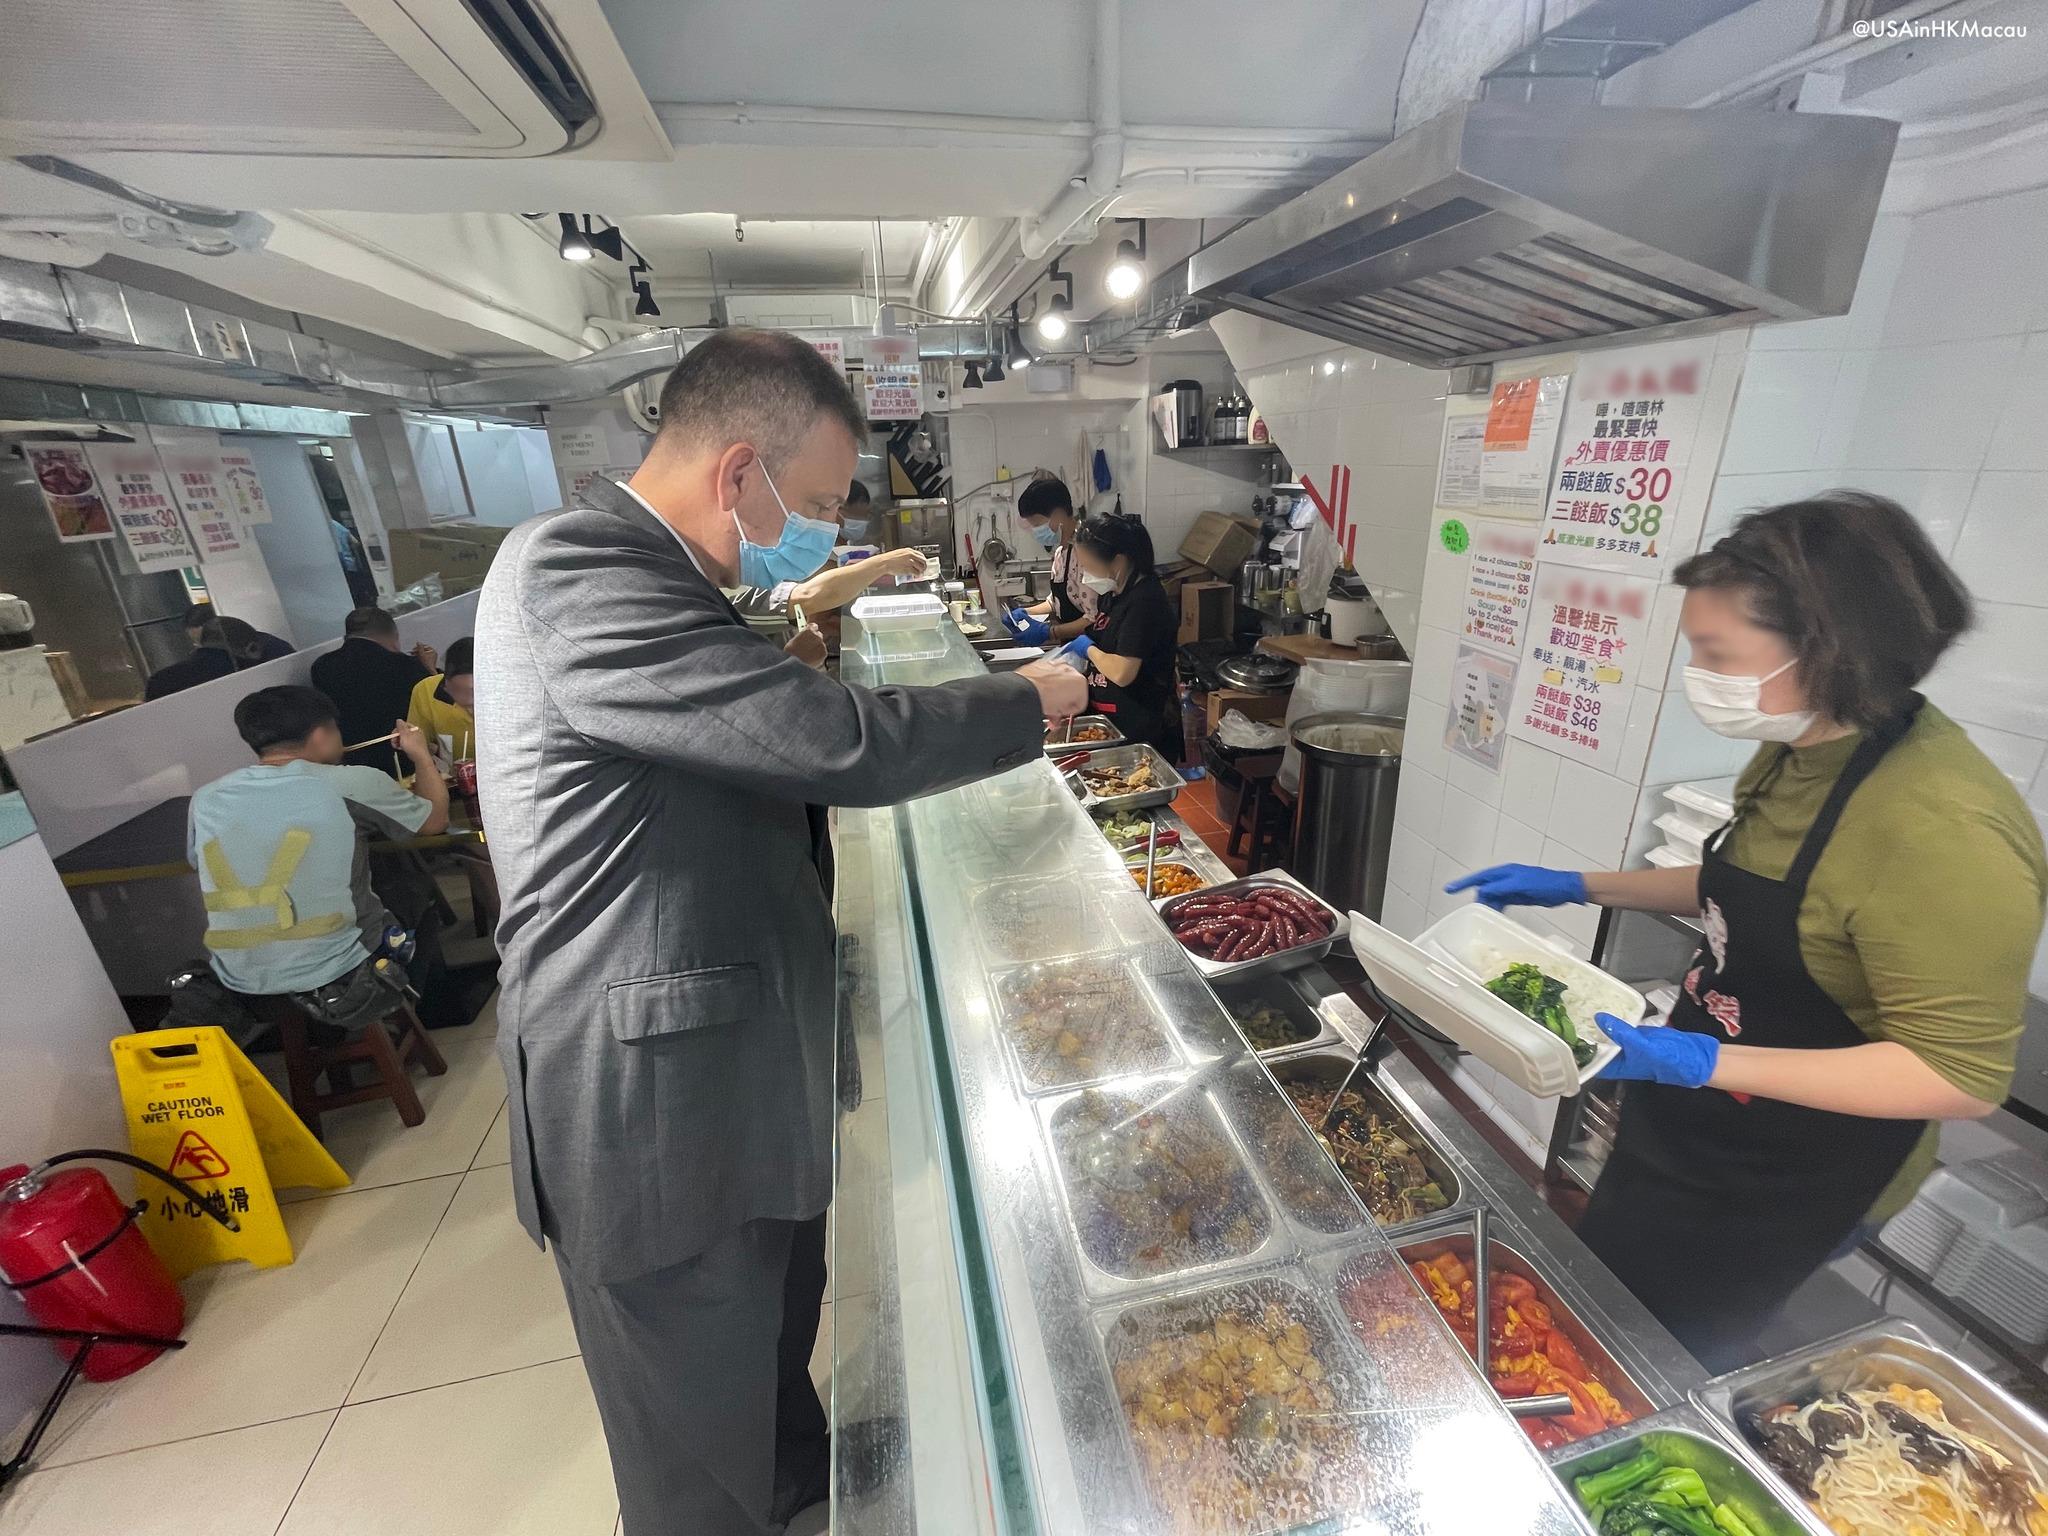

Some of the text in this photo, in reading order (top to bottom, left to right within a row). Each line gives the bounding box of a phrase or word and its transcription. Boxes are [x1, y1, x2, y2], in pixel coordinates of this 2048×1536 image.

[1593, 418, 1658, 438] 最緊要快
[1575, 440, 1670, 462] 外賣優惠價
[1614, 467, 1672, 502] $30
[1609, 503, 1662, 537] $38
[1516, 572, 1531, 583] $38
[1517, 584, 1529, 595] $5
[1477, 599, 1496, 612] Soup
[1468, 607, 1518, 627] Up to 2 choices
[1552, 604, 1618, 635] 溫馨提示
[1473, 627, 1506, 643] Thank you
[1550, 627, 1615, 660] 歡迎堂食
[147, 1096, 212, 1113] CAUTION
[142, 1106, 225, 1124] WET FLOOR
